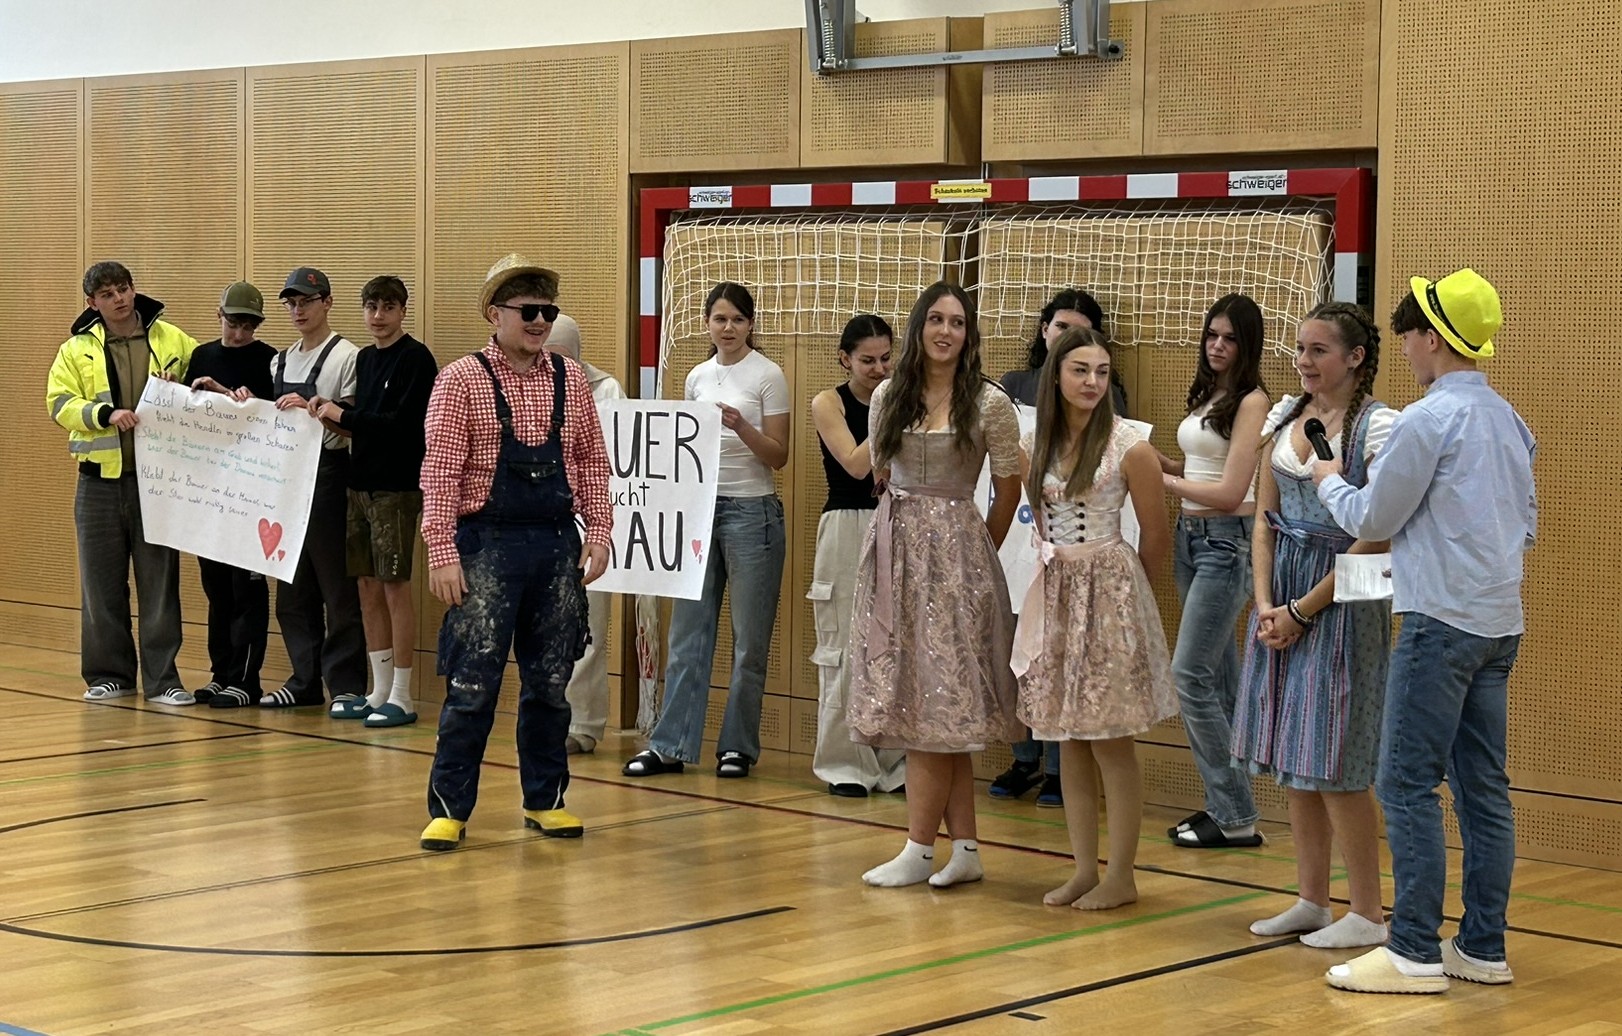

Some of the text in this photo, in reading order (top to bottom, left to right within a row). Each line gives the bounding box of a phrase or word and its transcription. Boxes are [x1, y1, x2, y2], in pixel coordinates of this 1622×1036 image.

[204, 399, 238, 420] Bauer
[609, 411, 703, 483] UER
[610, 481, 650, 507] ucht
[609, 511, 684, 572] AU
